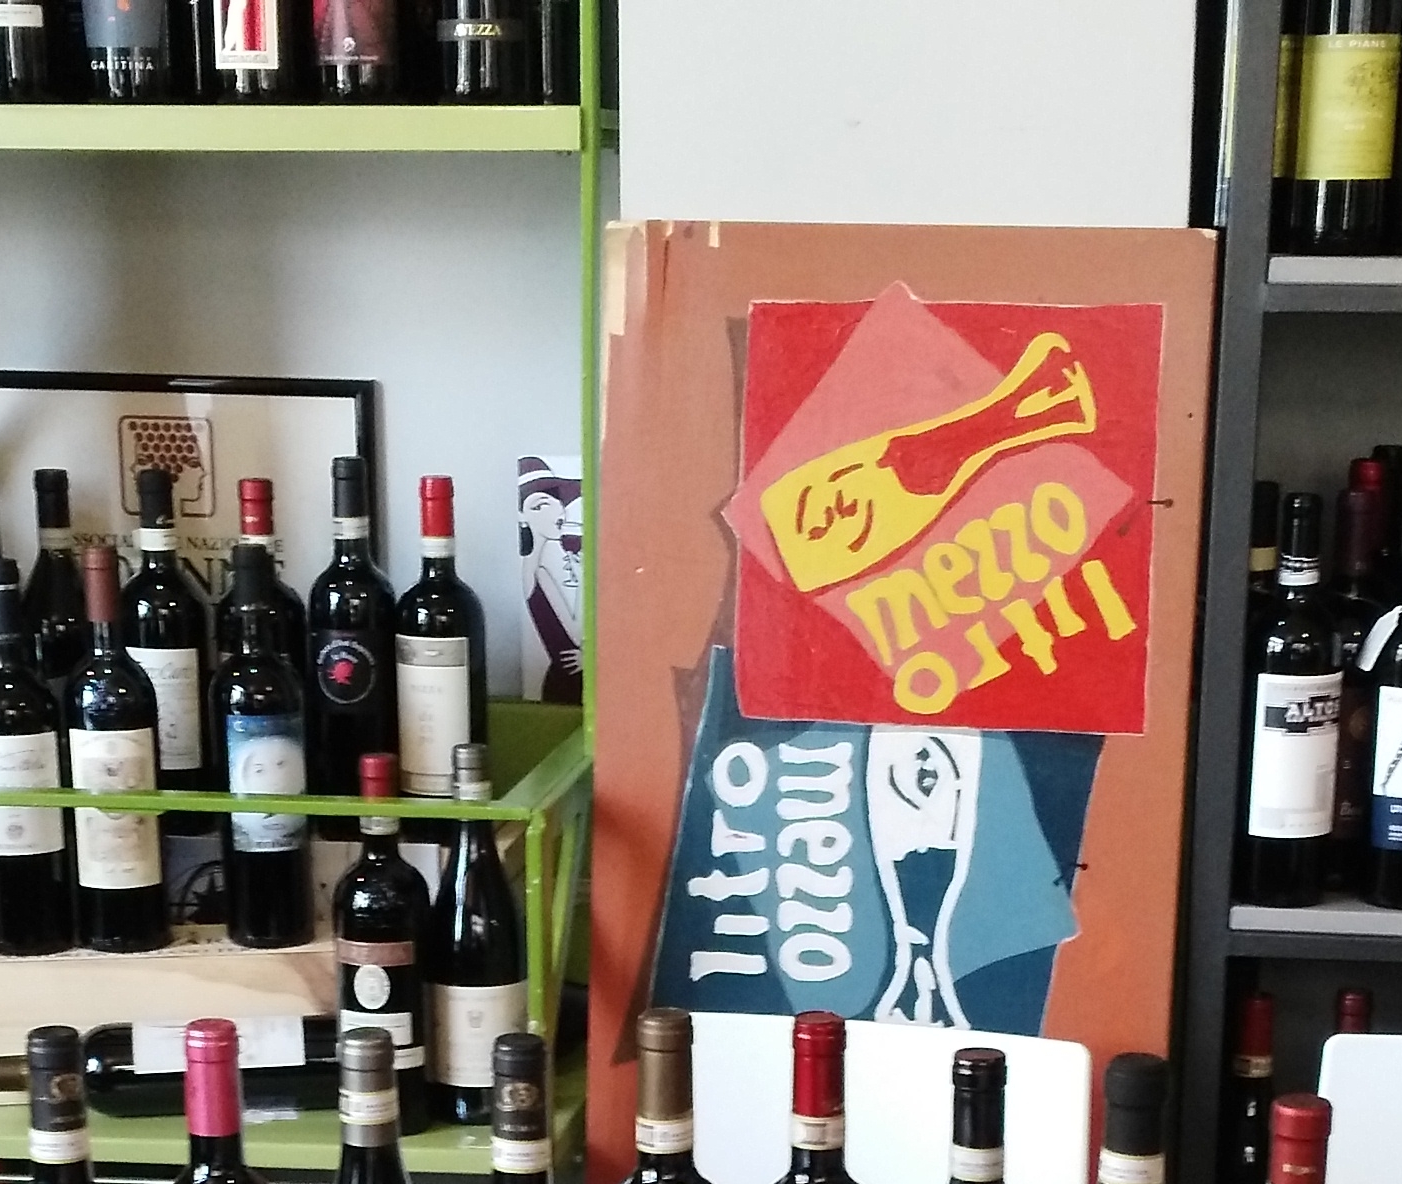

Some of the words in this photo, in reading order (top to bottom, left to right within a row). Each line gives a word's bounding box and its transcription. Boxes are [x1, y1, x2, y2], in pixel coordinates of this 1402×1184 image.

[844, 481, 1087, 666] mezzo
[894, 559, 1136, 714] litro
[688, 741, 769, 980] litro
[776, 742, 854, 981] mezzo
